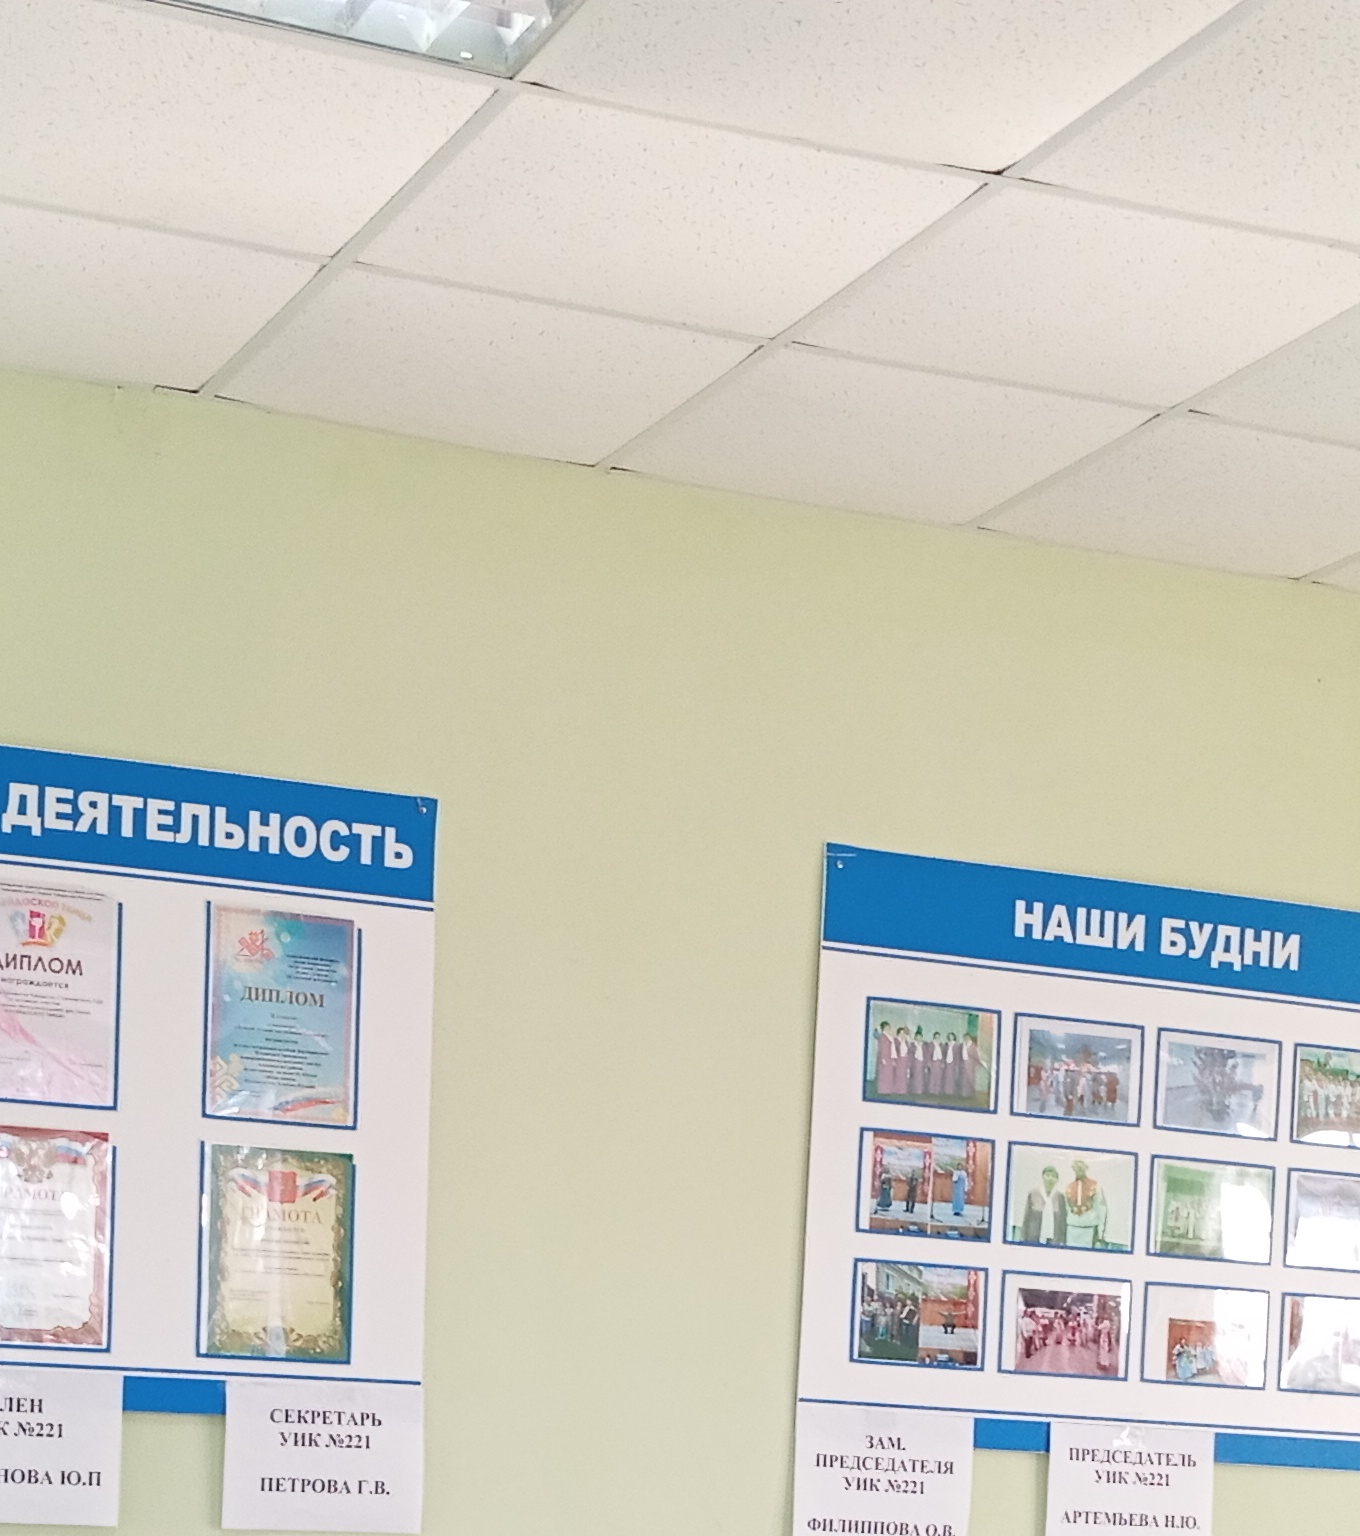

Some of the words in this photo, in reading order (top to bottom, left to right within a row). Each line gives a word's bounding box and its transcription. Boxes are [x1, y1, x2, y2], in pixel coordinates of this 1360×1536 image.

[1, 782, 414, 870] ДЕЯТЕЛЬНОСТЬ
[1014, 899, 1146, 952] НАШИ
[1160, 917, 1301, 972] БУДНИ
[240, 985, 325, 1008] ДИПЛОМ
[269, 1408, 382, 1427] СЕКРЕТАРЬ
[13, 1421, 64, 1438] №221
[278, 1431, 321, 1448] УИК
[325, 1433, 371, 1450] №221
[865, 1435, 906, 1451] ЗАМ.
[814, 1452, 955, 1475] ПРЕДСЕДАТЕЛЯ
[1068, 1447, 1197, 1468] ПРЕДСЕДАТЕЛЬ
[260, 1476, 351, 1495] ПЕТРОВА
[357, 1480, 391, 1495] Г.В.
[842, 1476, 881, 1492] УИК
[884, 1479, 925, 1495] №221
[1094, 1469, 1130, 1485] УИК
[1132, 1471, 1171, 1487] №221
[1061, 1509, 1160, 1528] АРТЕМЬЕВА
[1164, 1515, 1201, 1531] Н.Ю.
